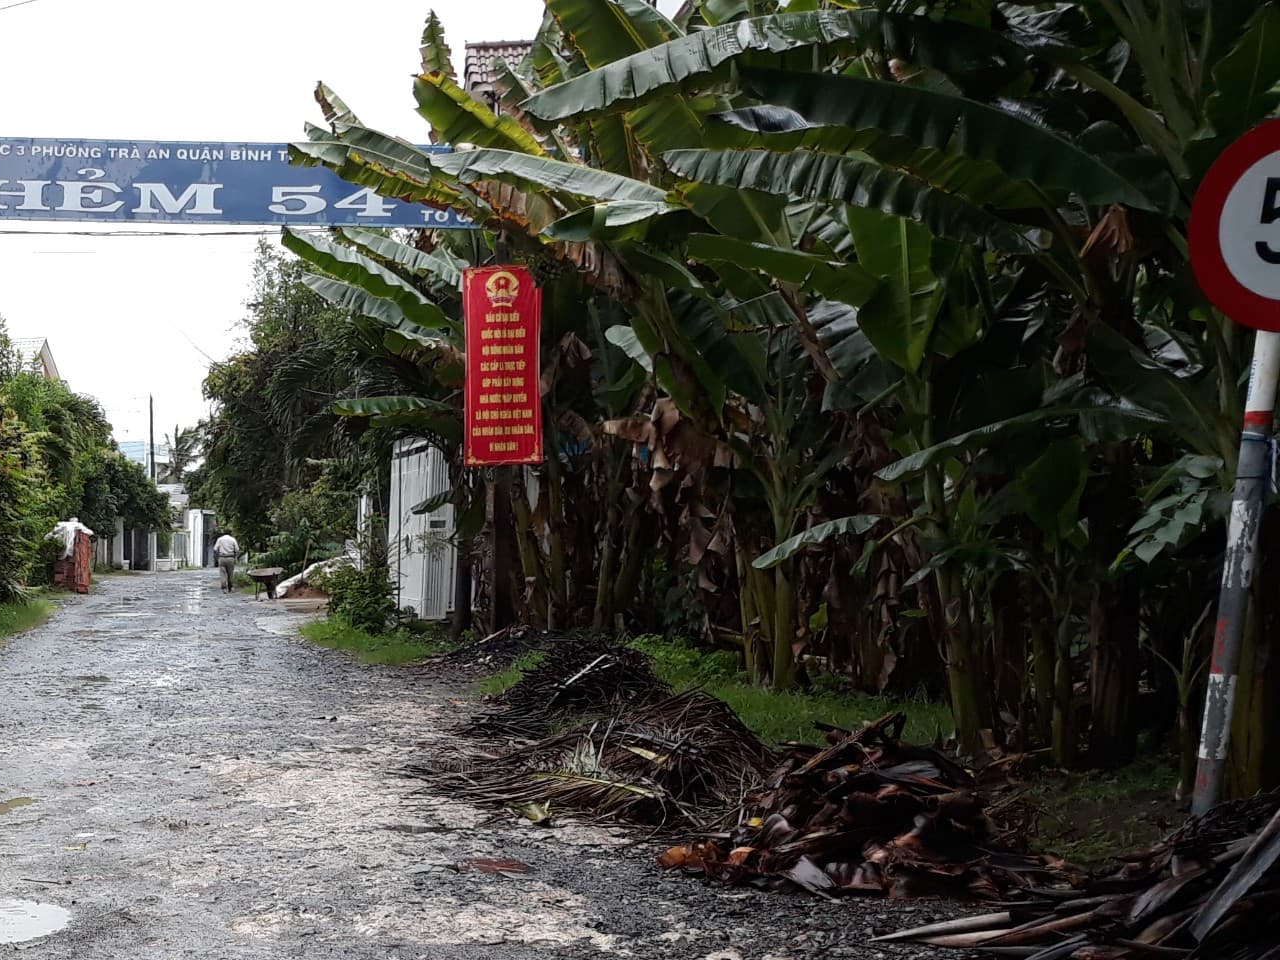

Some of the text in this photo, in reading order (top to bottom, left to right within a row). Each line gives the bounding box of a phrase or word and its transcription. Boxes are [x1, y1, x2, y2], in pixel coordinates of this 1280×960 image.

[16, 145, 25, 156] 3
[31, 143, 101, 159] PHƯỜNG
[108, 145, 140, 159] TRÀ
[148, 149, 170, 160] AN
[177, 147, 224, 163] QUẬN
[231, 147, 271, 161] BÌNH
[267, 184, 397, 217] 54
